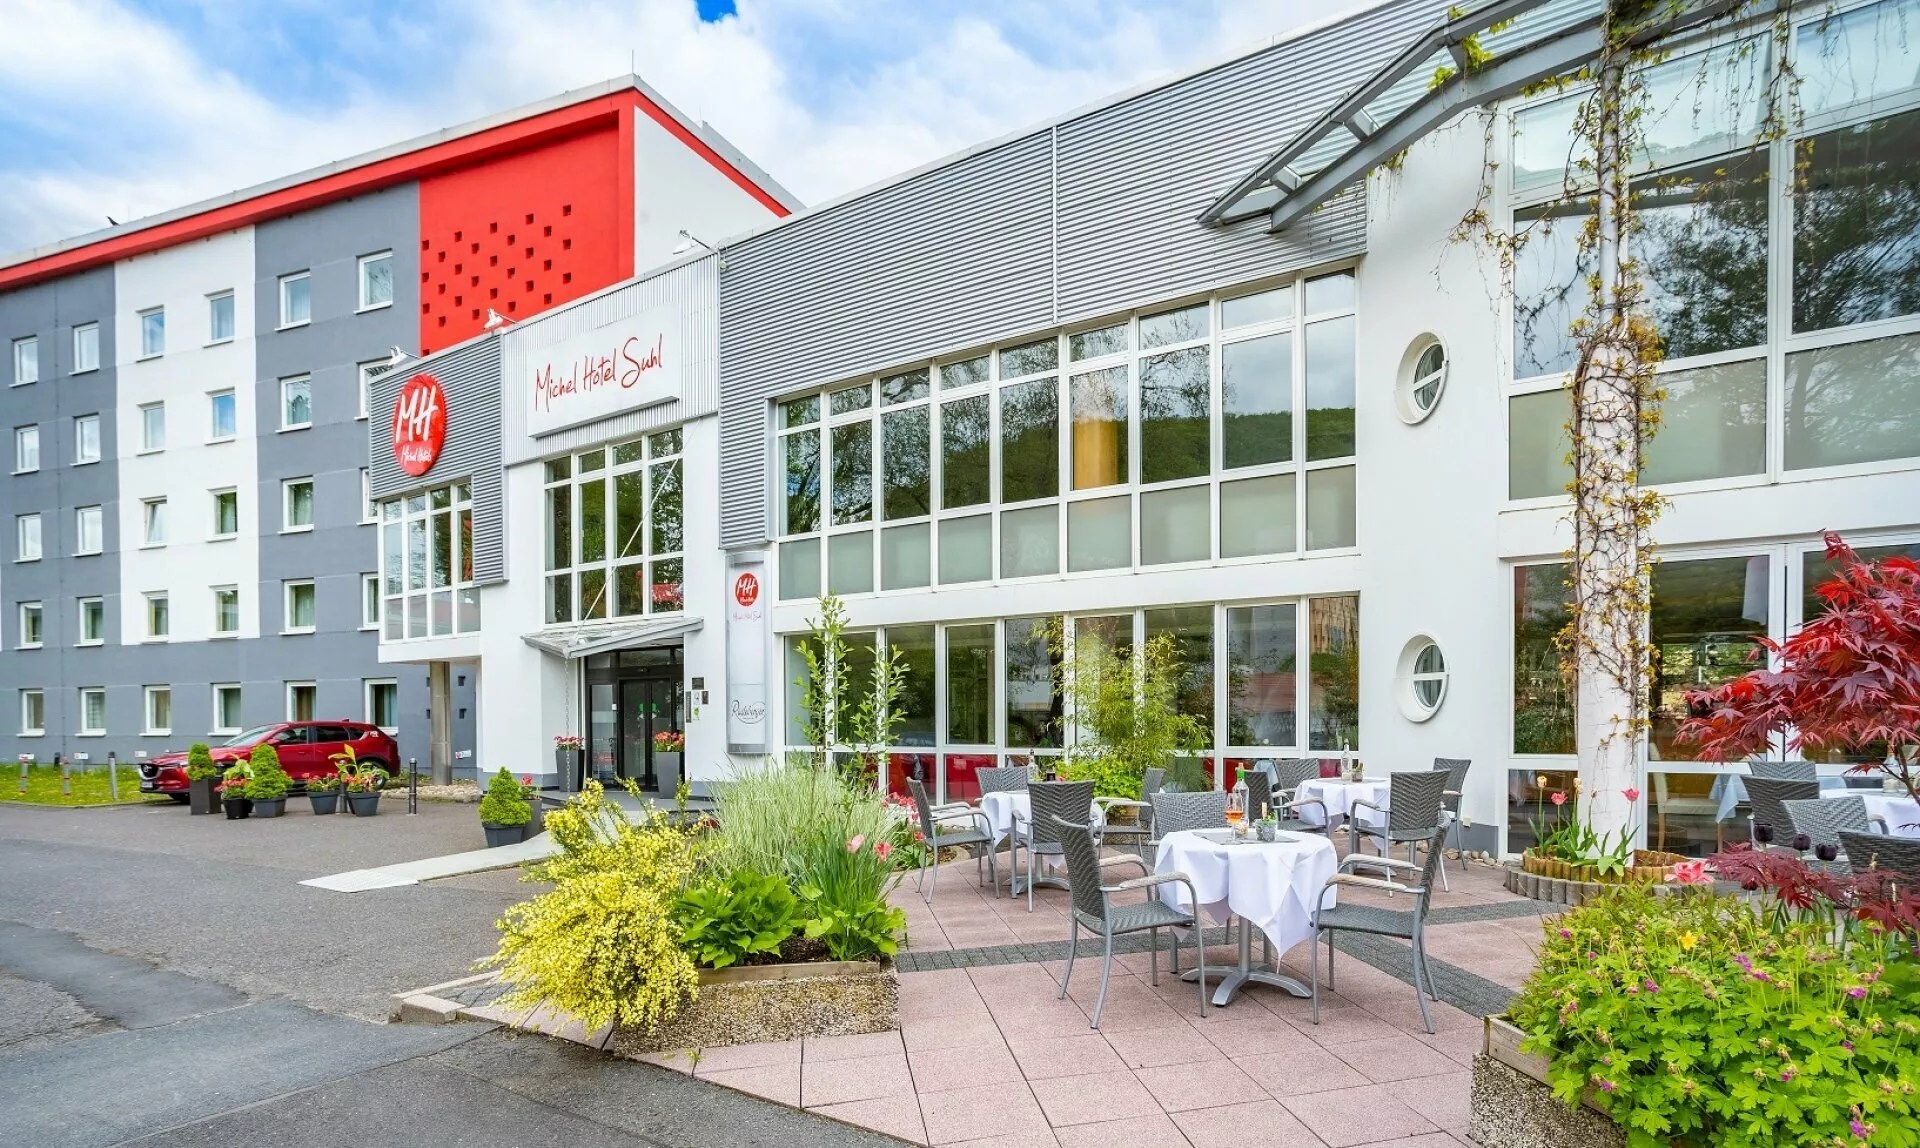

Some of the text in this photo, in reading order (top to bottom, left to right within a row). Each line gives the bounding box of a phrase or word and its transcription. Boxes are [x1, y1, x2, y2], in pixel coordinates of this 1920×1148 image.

[535, 333, 663, 412] Michel Hotel Suhl
[395, 384, 439, 444] MH
[736, 577, 757, 597] MH
